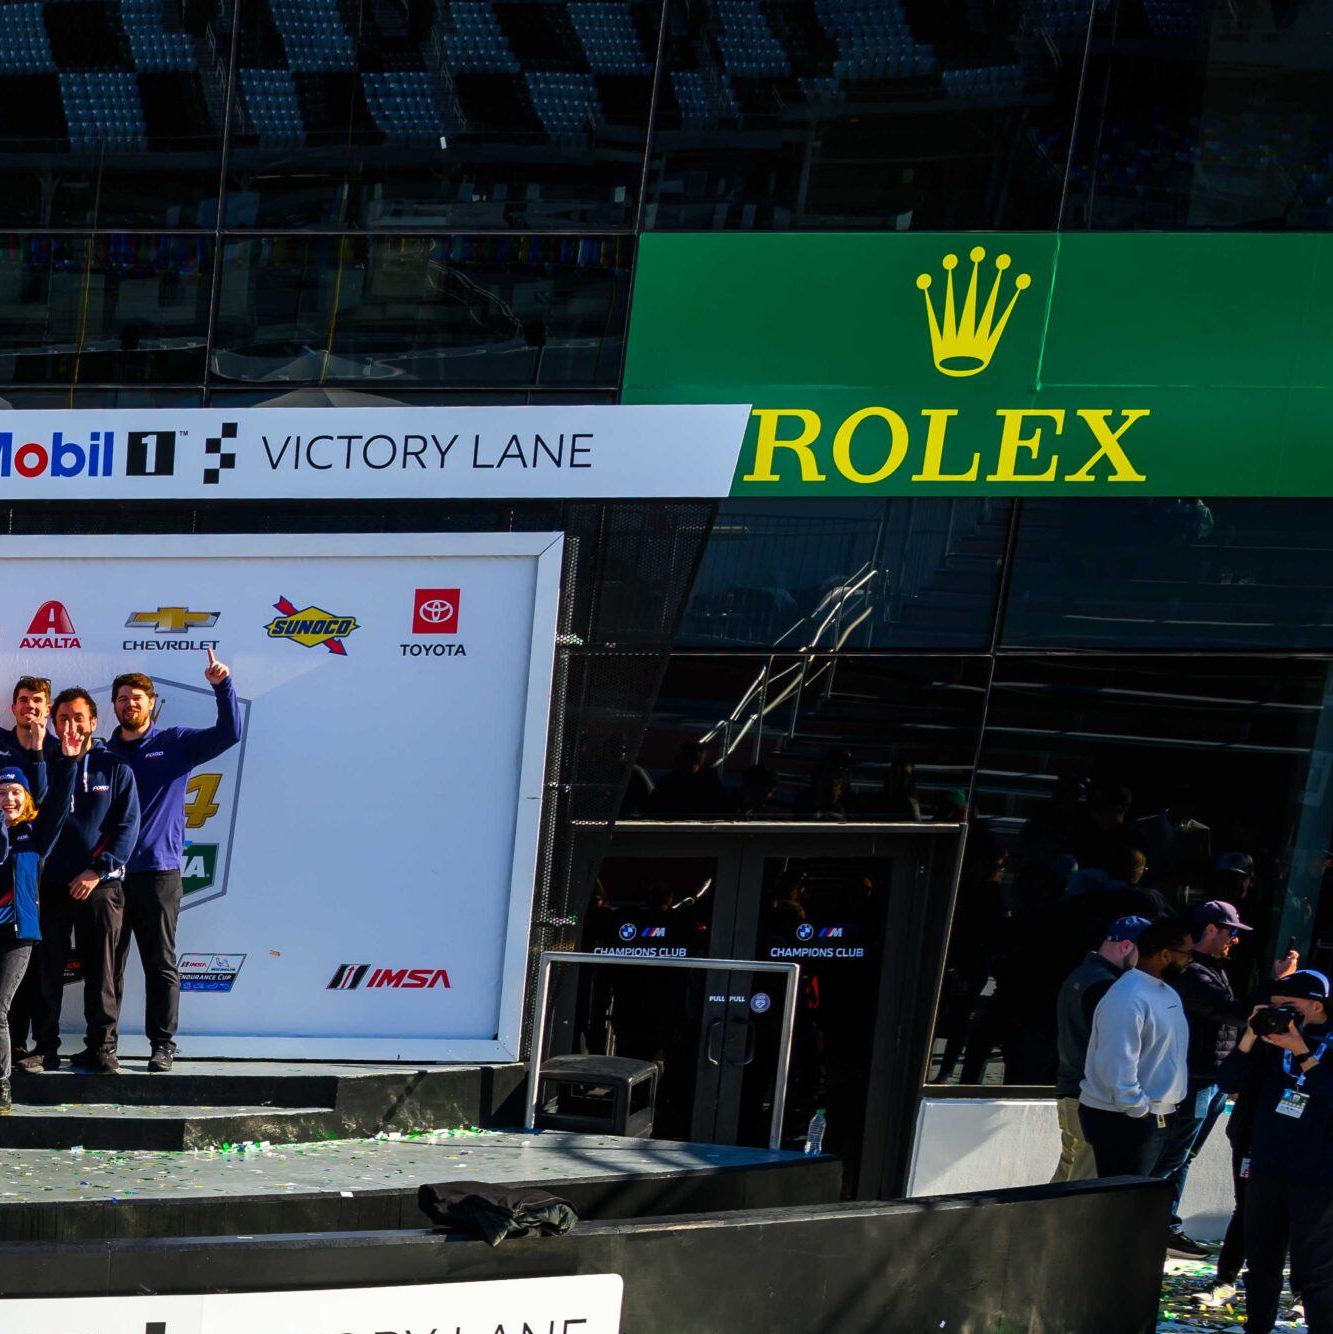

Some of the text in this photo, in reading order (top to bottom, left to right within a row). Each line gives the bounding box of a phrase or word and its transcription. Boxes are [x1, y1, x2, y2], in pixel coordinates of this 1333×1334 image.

[262, 433, 594, 470] VICTORY LANE
[744, 406, 1150, 484] ROLEX
[140, 434, 164, 474] 1
[269, 617, 357, 637] SUNOCO
[19, 637, 81, 649] AXALTA
[122, 640, 220, 651] CHEVROLET
[399, 644, 467, 657] TOYOTA
[594, 947, 687, 957] CHAMPIONS CLUB
[770, 947, 864, 957] CHAMPIONS CLUB
[367, 969, 451, 989] IMSA
